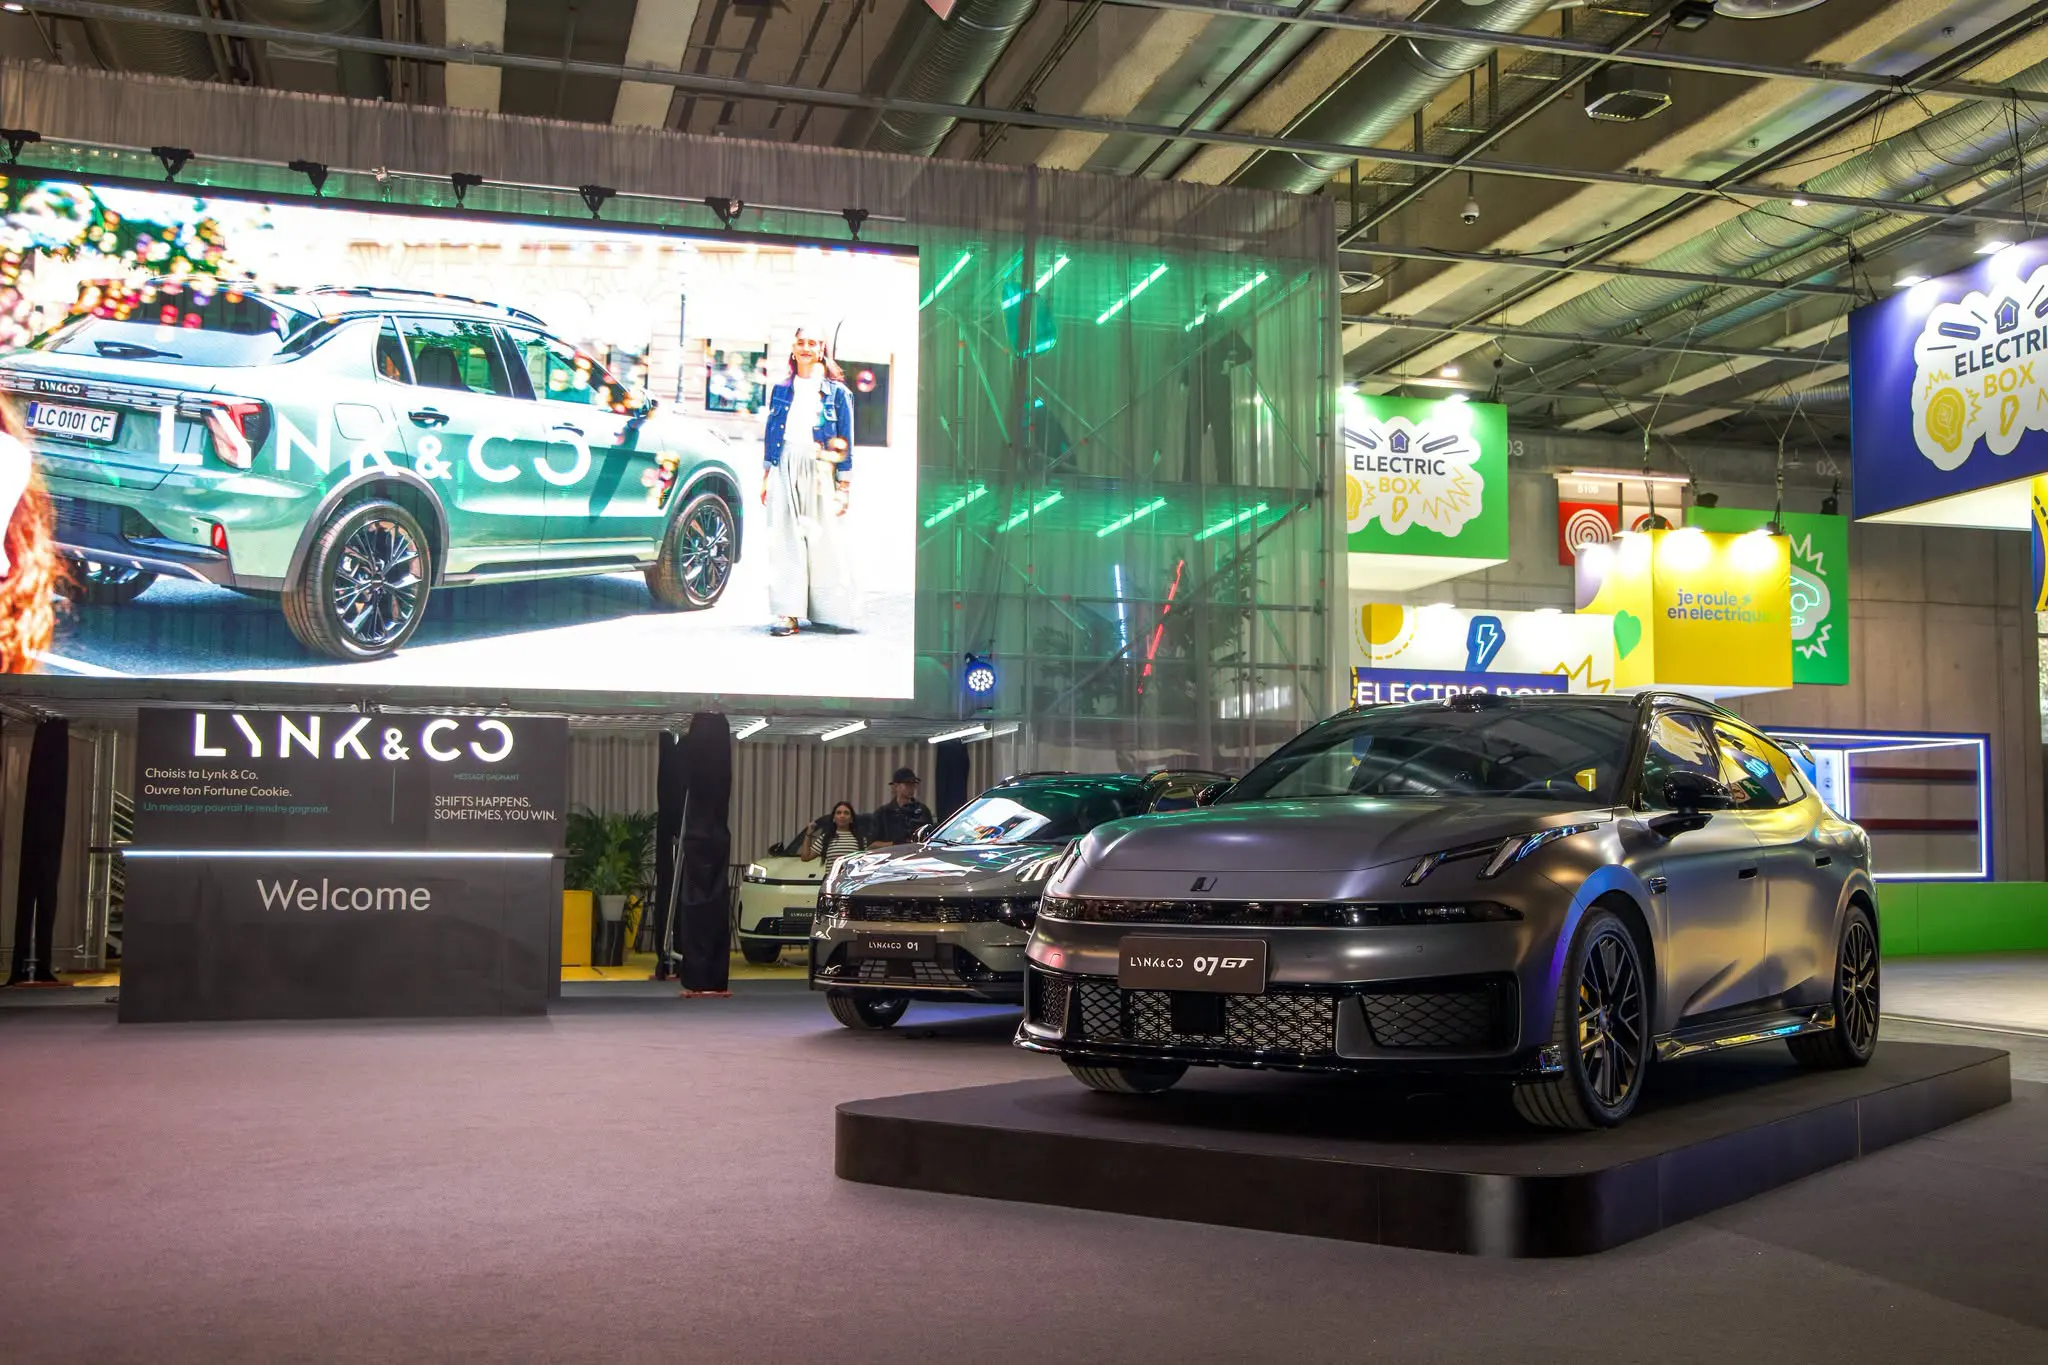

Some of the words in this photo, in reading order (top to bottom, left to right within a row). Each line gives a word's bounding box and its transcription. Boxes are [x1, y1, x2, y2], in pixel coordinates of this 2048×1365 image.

[1983, 361, 2036, 399] BOX
[38, 407, 56, 426] LC
[58, 411, 87, 430] 0101
[91, 415, 111, 433] CF
[1354, 454, 1446, 476] ELECTRIC
[1378, 476, 1422, 495] BOX
[1677, 588, 1693, 607] je
[1697, 591, 1738, 606] roule
[1667, 606, 1687, 619] en
[145, 767, 186, 779] Choisis
[188, 769, 199, 779] ta
[202, 769, 228, 781] Lynk
[230, 769, 240, 779] &
[240, 769, 259, 780] Co.
[144, 784, 181, 796] Ouvre
[183, 786, 201, 796] ton
[203, 785, 248, 796] Fortune
[250, 786, 293, 797] Cookie.
[143, 802, 157, 811] Un
[159, 804, 202, 814] message
[204, 803, 243, 814] pourrait
[434, 795, 473, 807] SHIFTS
[475, 796, 532, 808] HAPPENS.
[434, 808, 503, 821] SOMETIMES,
[504, 810, 528, 820] YOU
[530, 810, 557, 821] WIN.
[256, 877, 431, 912] Welcome
[907, 941, 919, 951] 01
